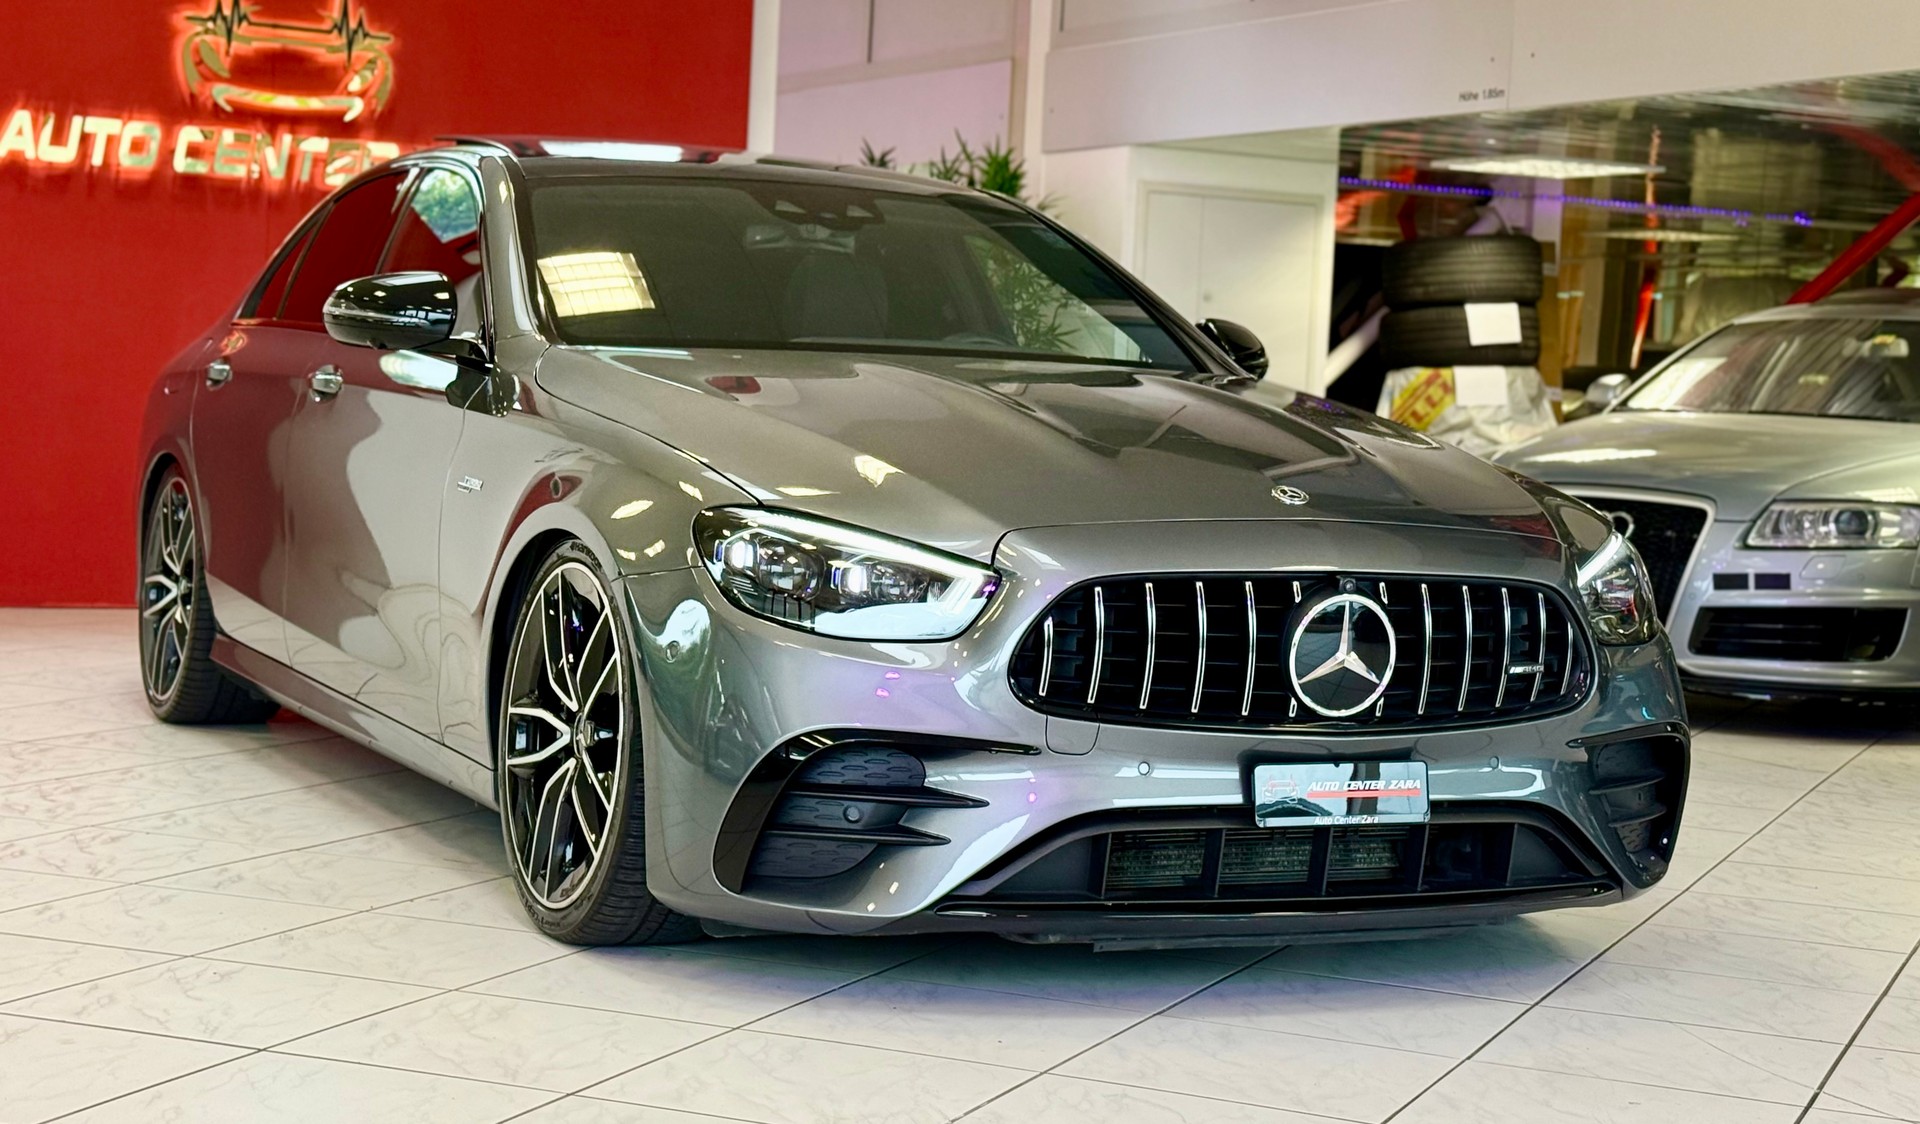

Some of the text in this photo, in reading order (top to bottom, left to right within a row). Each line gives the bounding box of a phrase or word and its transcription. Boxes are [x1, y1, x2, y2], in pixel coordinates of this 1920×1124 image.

[0, 109, 161, 167] AUTO
[1308, 779, 1421, 791] AUTO CENTER ZARA
[1313, 815, 1379, 825] Auto Center Zara
